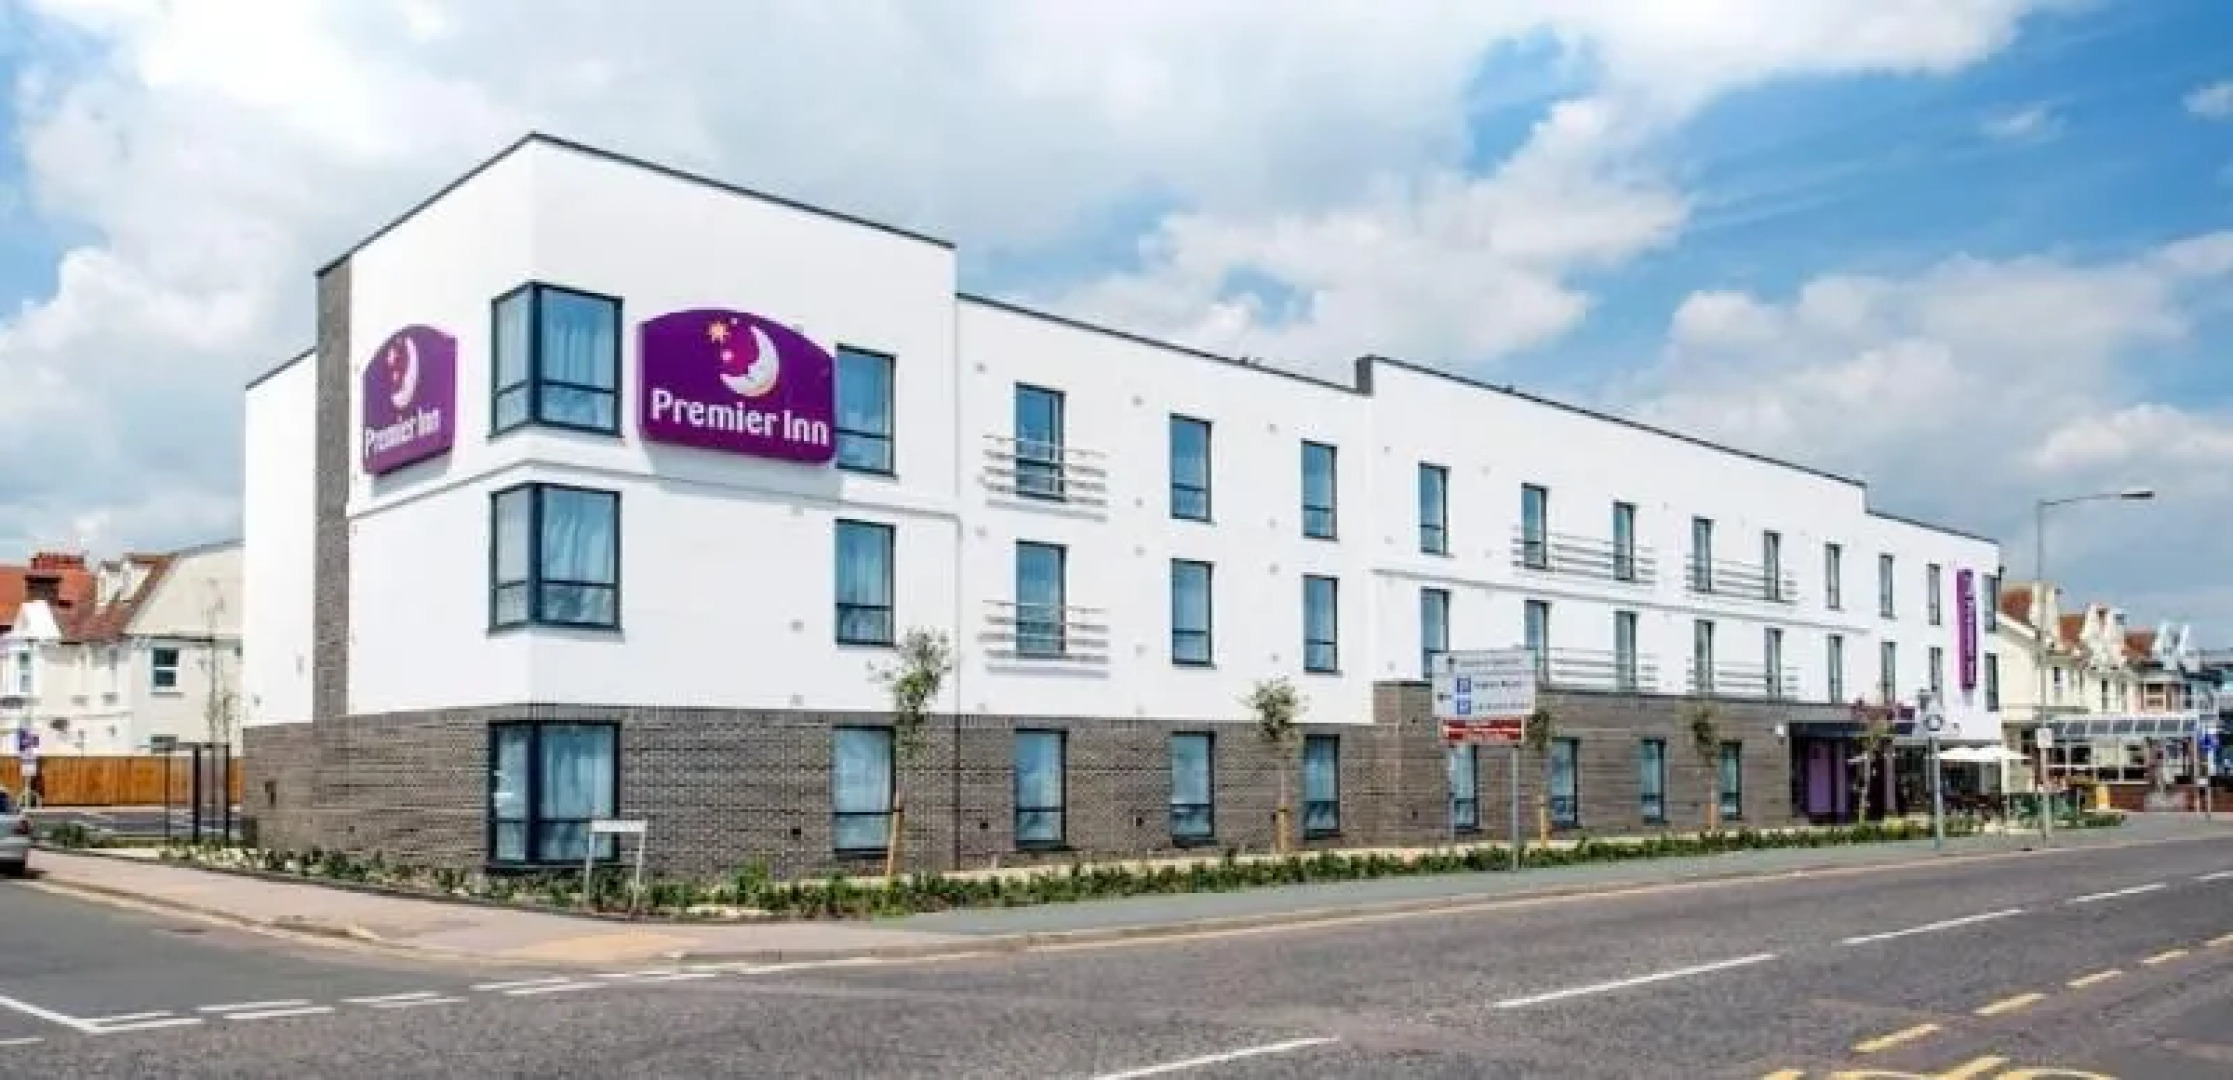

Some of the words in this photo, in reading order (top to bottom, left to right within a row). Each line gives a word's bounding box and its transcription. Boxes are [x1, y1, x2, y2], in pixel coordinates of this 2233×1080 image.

[418, 407, 441, 437] Inn
[652, 387, 779, 437] Premier
[783, 409, 830, 446] Inn
